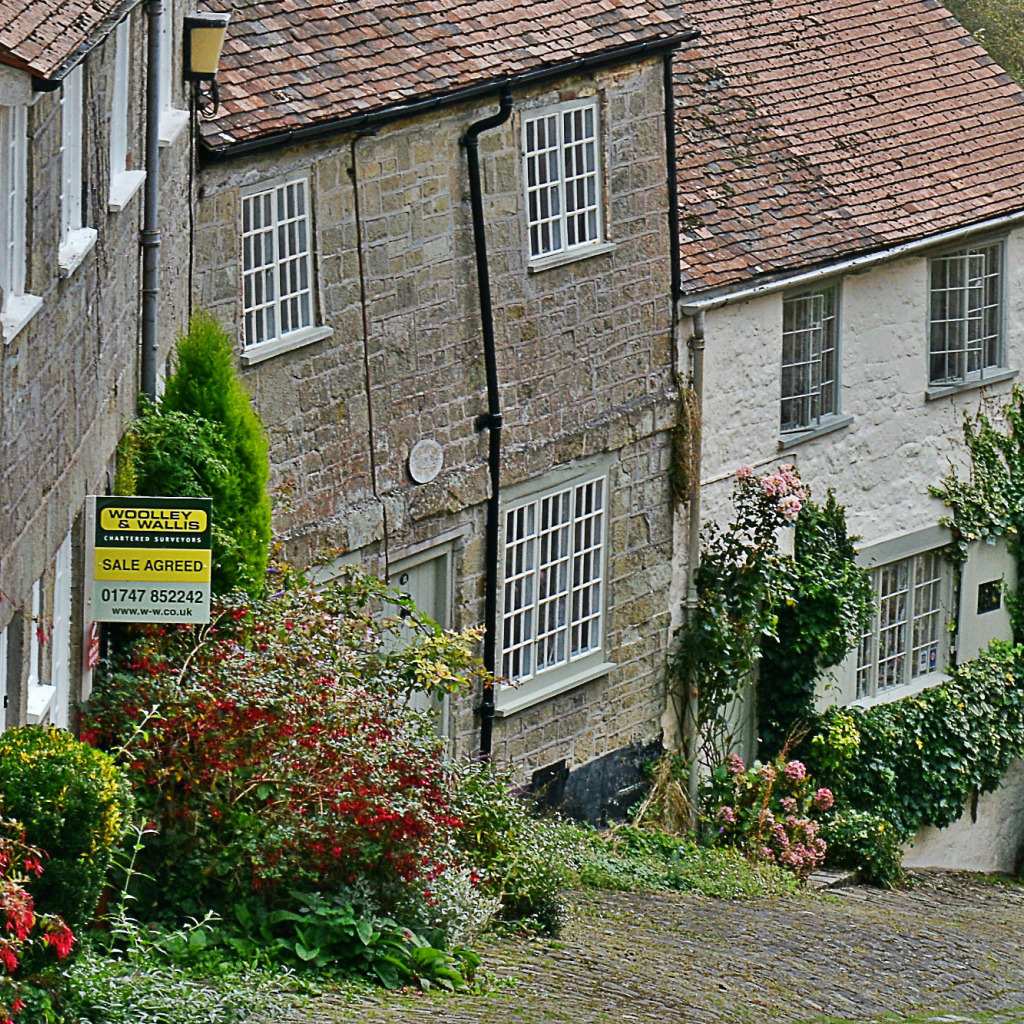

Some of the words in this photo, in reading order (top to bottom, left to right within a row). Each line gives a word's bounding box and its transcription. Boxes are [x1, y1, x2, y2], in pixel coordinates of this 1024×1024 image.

[109, 509, 192, 519] WOOLLEY
[118, 520, 130, 529] &
[137, 520, 200, 530] WALLIS
[103, 559, 140, 571] SALE
[144, 560, 203, 572] AGREED
[101, 588, 146, 603] 01747
[150, 589, 203, 604] 852242
[112, 607, 193, 617] www.w-w.co.uk
